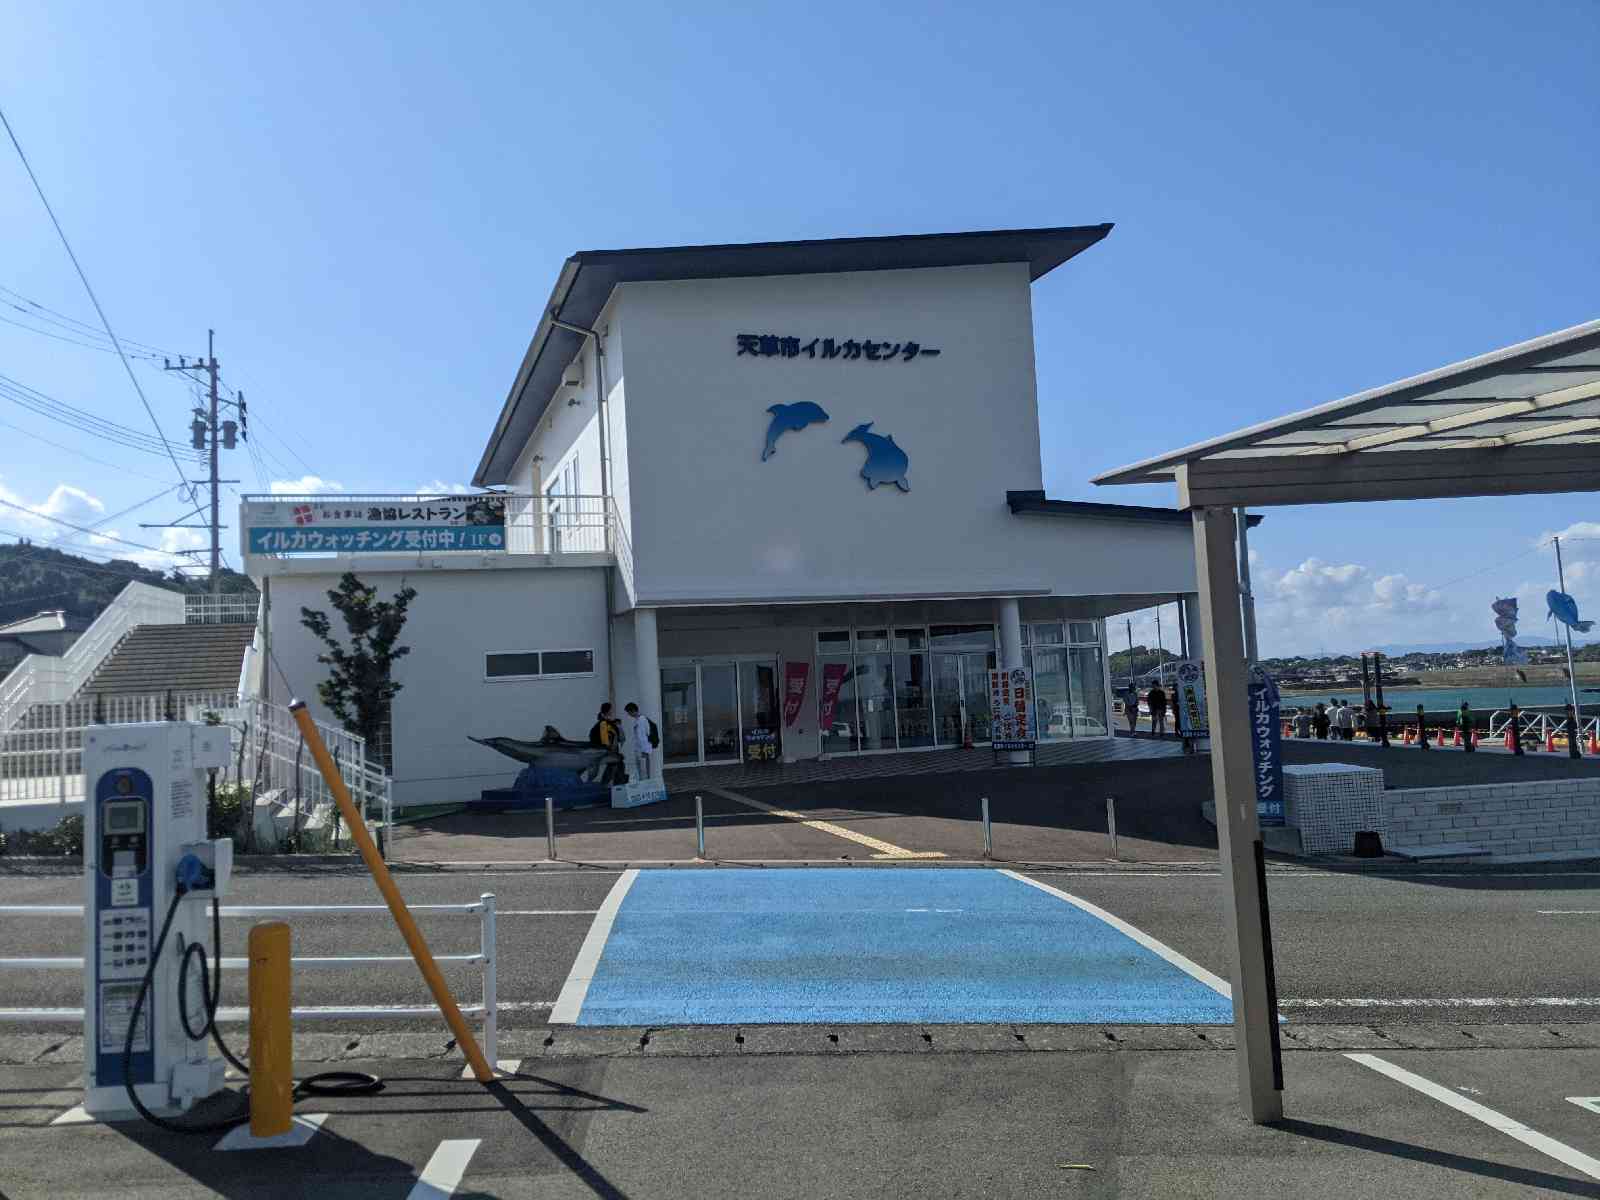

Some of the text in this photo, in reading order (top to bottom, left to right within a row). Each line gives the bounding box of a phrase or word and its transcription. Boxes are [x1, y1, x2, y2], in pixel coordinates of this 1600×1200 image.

[736, 334, 941, 361] 天草市イルカセンター
[1254, 688, 1274, 798] イルカウォッチング
